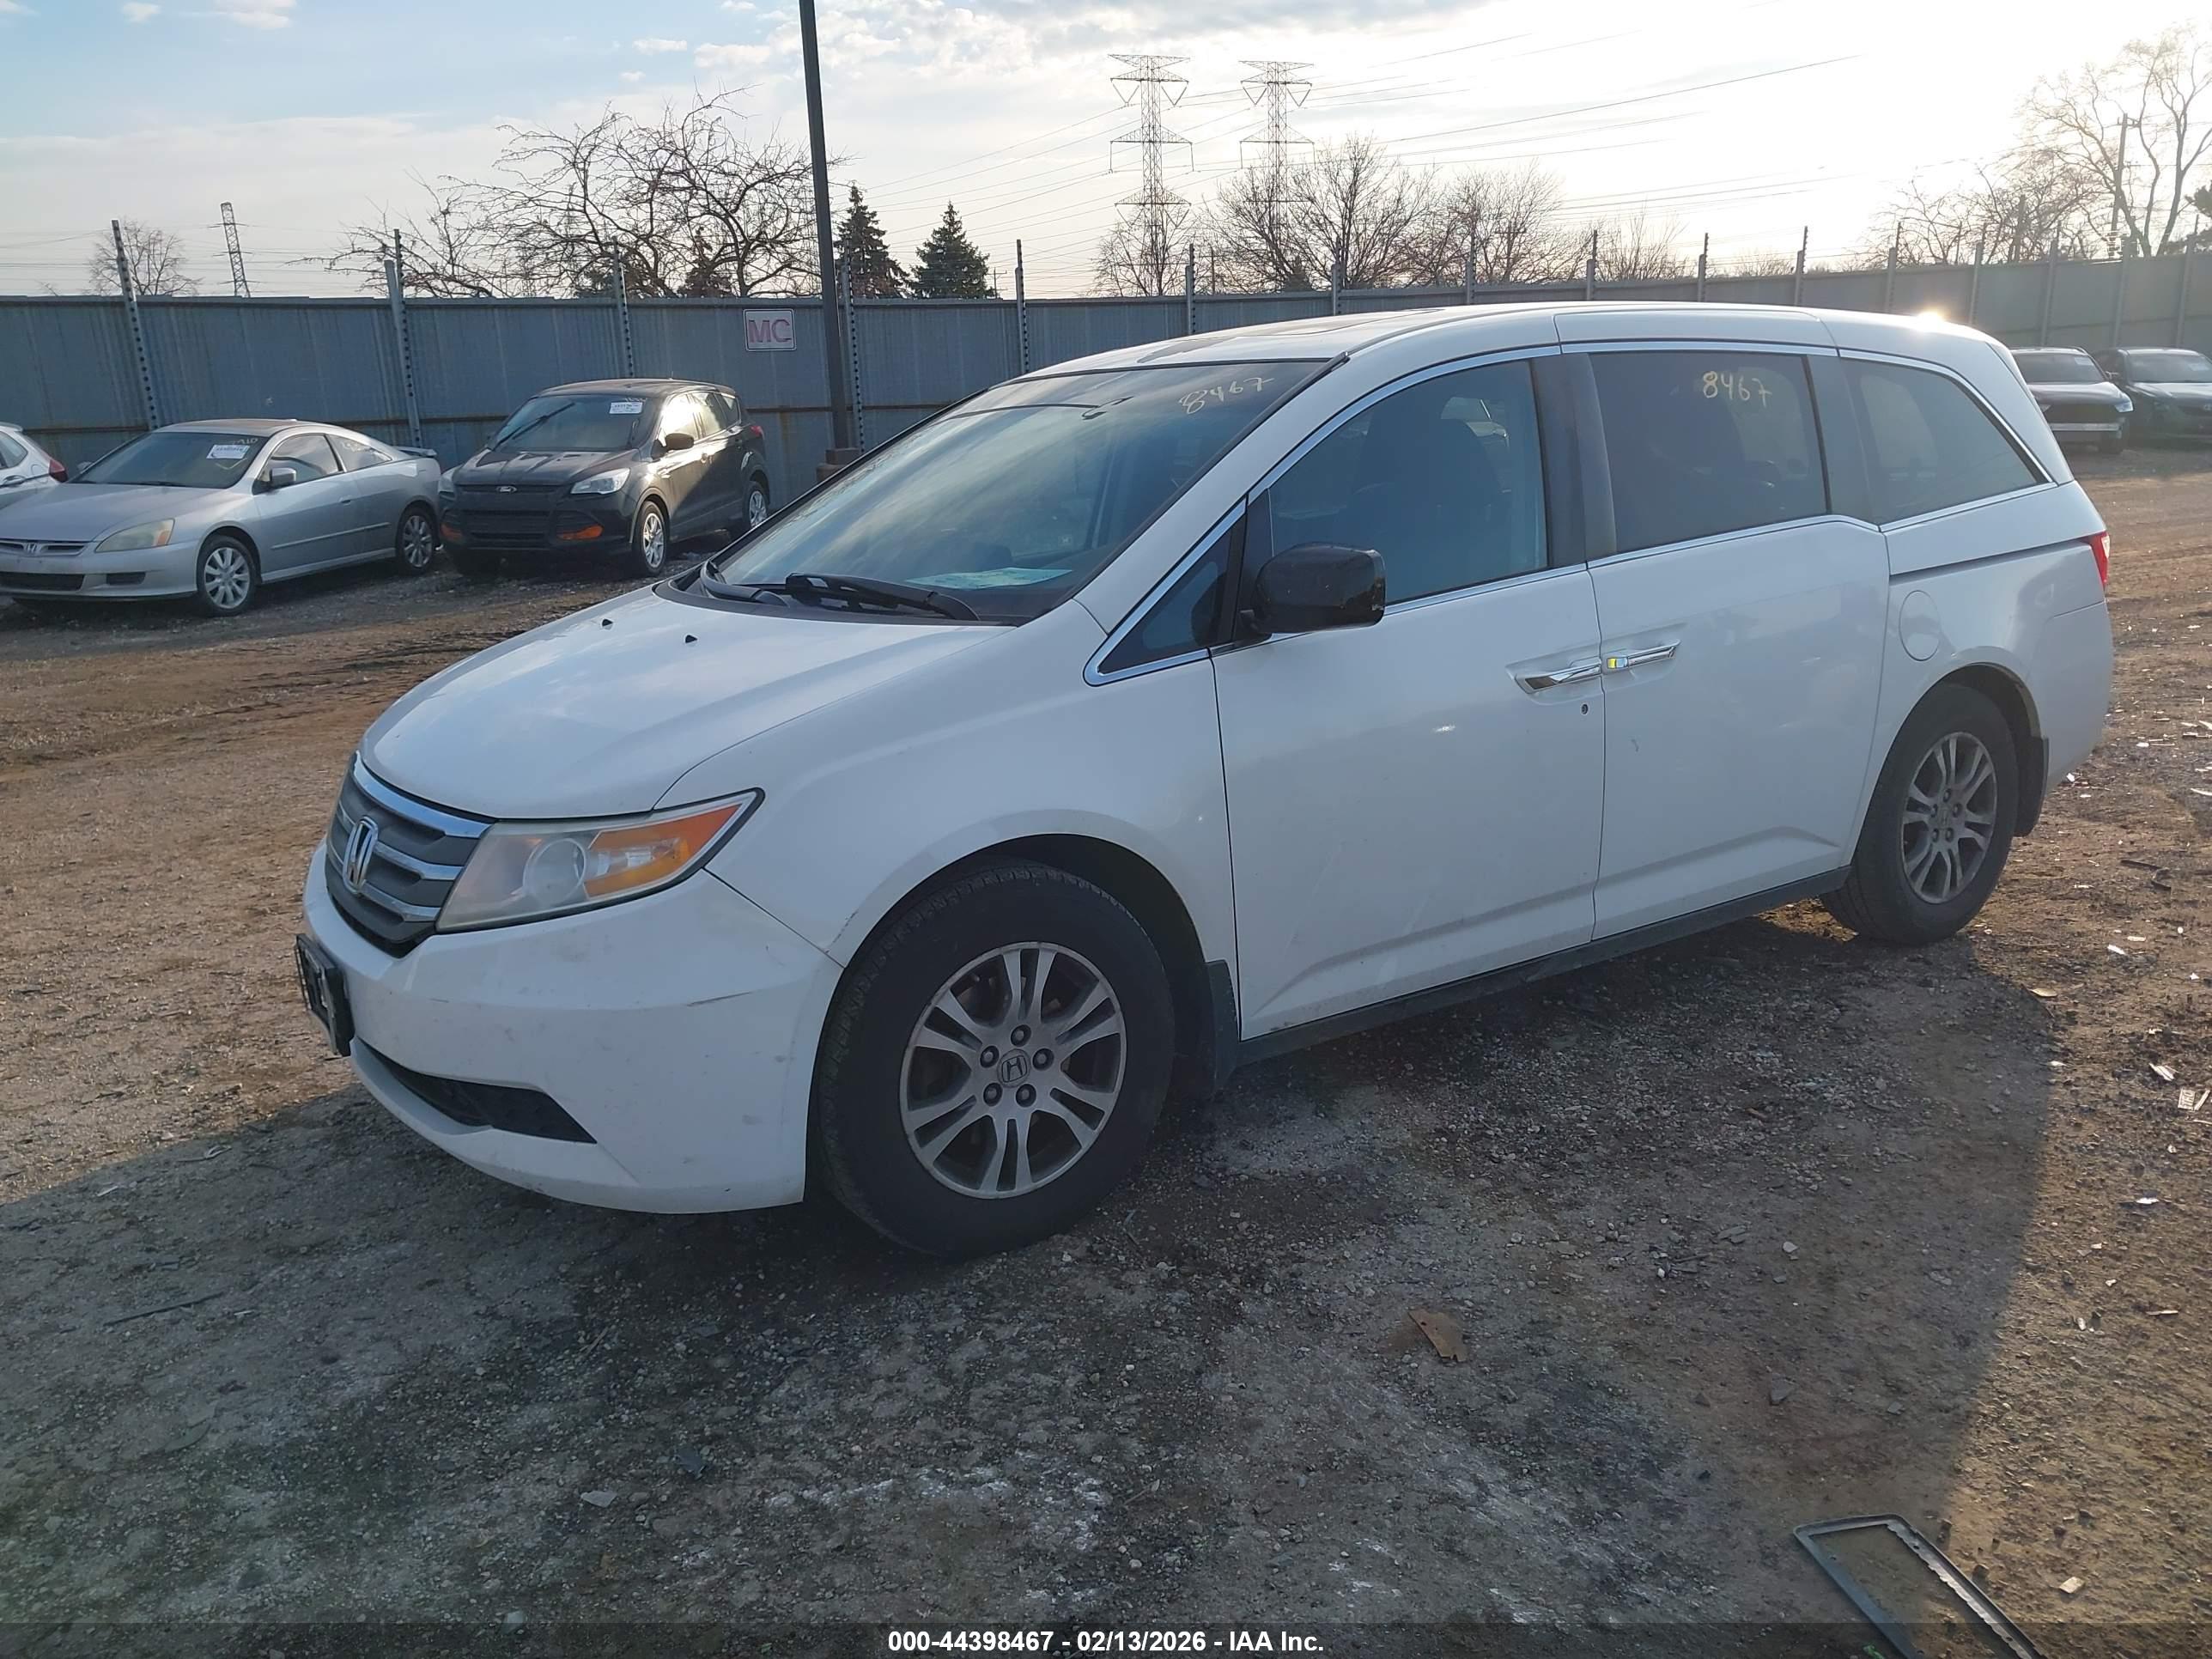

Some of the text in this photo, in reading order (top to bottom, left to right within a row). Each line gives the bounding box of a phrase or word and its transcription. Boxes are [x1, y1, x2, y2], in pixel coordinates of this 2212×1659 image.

[748, 319, 792, 343] MC
[1178, 376, 1275, 414] 8467
[1703, 370, 1772, 408] 8467
